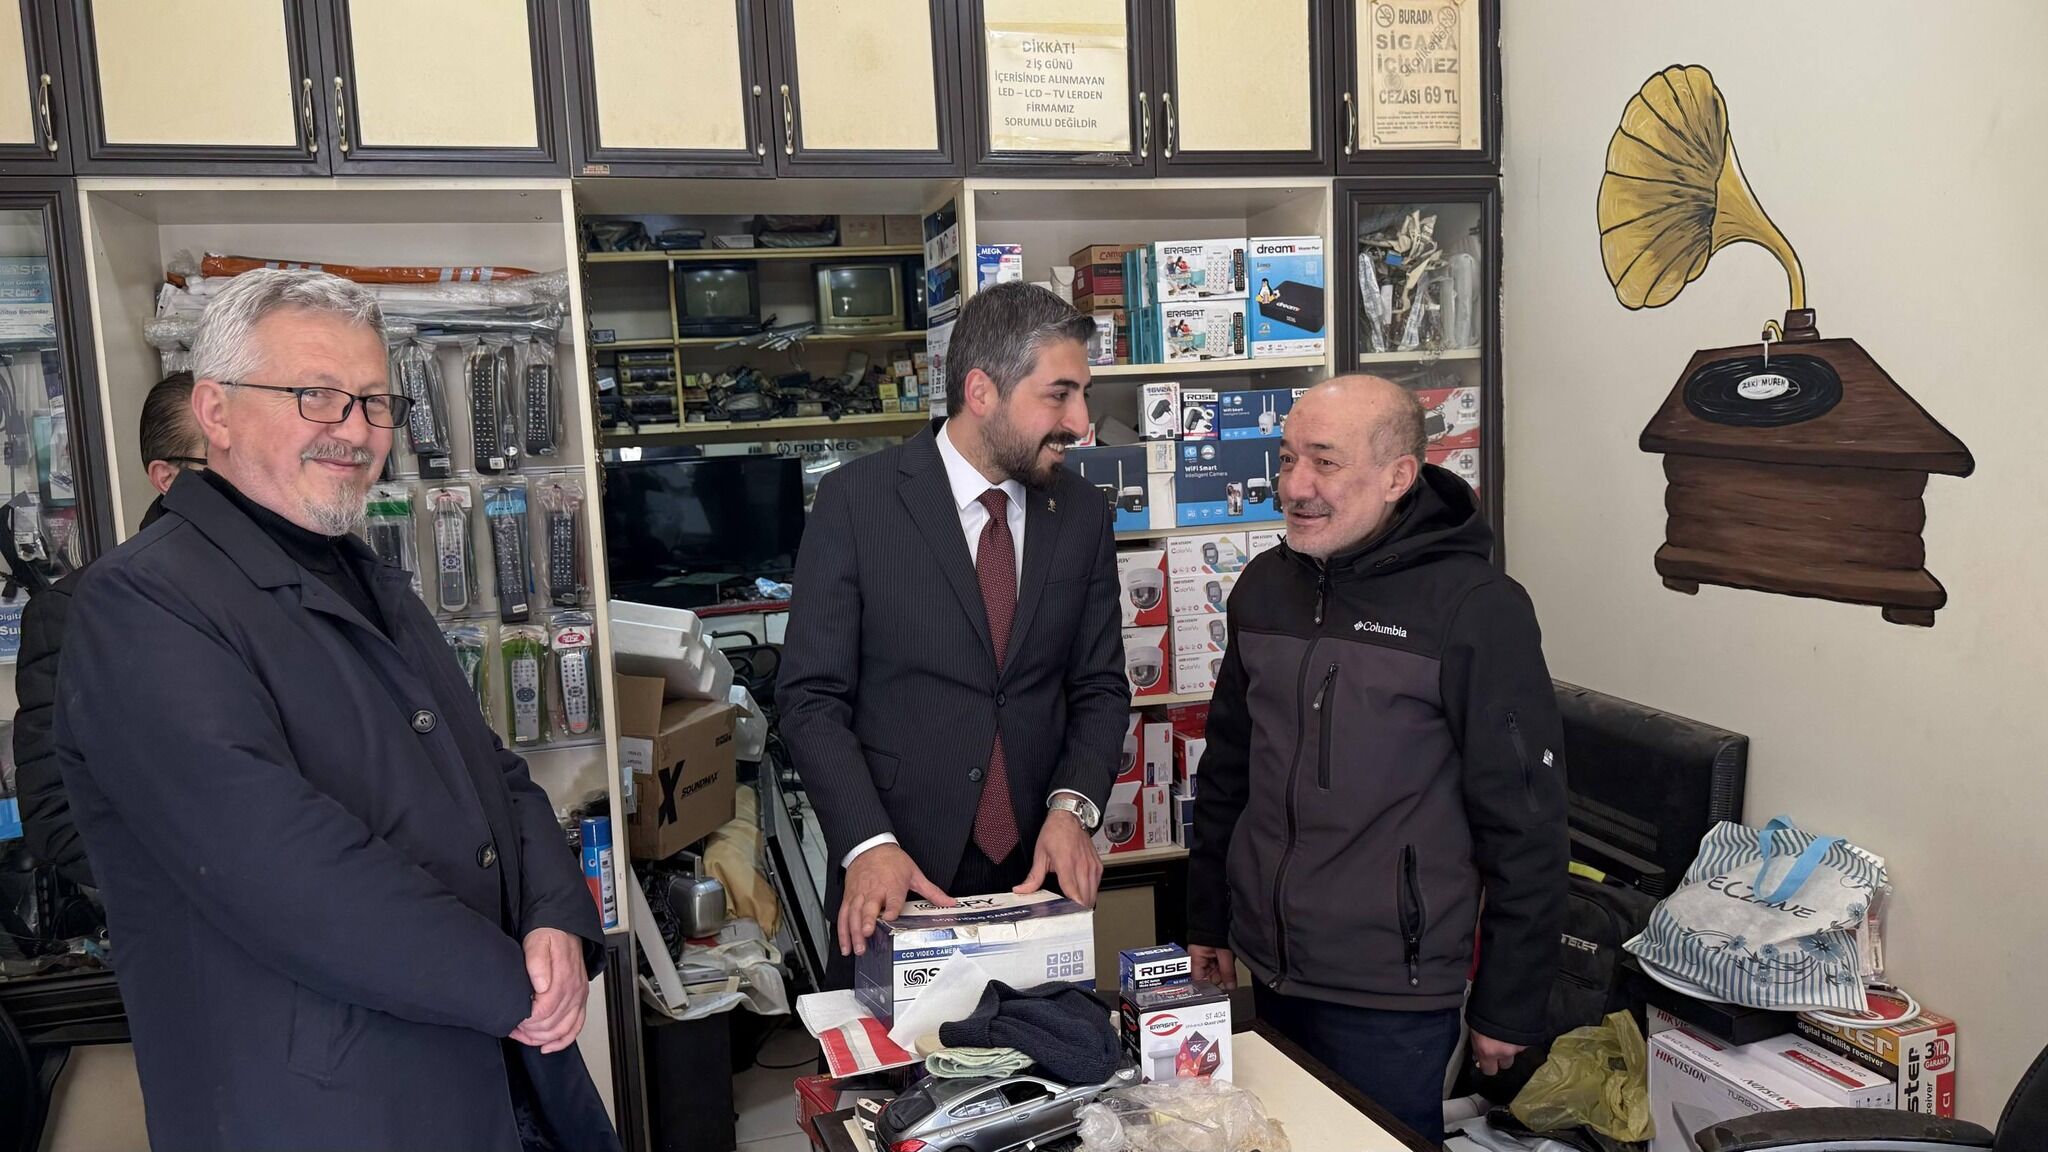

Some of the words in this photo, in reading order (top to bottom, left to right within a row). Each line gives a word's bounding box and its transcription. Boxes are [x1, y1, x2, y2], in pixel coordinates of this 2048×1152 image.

[1398, 9, 1434, 25] BURADA
[1022, 40, 1075, 55] DİKKAT!
[1025, 60, 1031, 69] 2
[1033, 59, 1042, 70] İŞ
[1045, 59, 1073, 70] GÜNÜ
[995, 71, 1046, 85] İÇERİSİNDE
[1048, 75, 1105, 86] ALINMAYAN
[998, 87, 1015, 97] LED
[1024, 89, 1042, 98] LCD
[1053, 90, 1065, 99] TV
[1067, 90, 1103, 100] LERDEN
[1424, 86, 1441, 104] 69
[1444, 89, 1458, 104] TL
[1026, 102, 1075, 114] FİRMAMIZ
[1004, 116, 1052, 128] SORUMLU
[1054, 116, 1097, 129] DEĞİLDİR
[1164, 246, 1203, 255] ERASAT
[1166, 309, 1205, 318] ERASAT
[794, 442, 858, 453] PIONEE
[1363, 621, 1407, 638] Columbia
[901, 951, 915, 959] CCD
[916, 949, 934, 957] VIDEO
[1140, 961, 1188, 977] ROSE
[1213, 1010, 1226, 1018] 404
[1656, 1009, 1688, 1028] HIKVI
[1149, 1021, 1179, 1031] ERASAT
[1797, 1021, 1821, 1037] digital
[1821, 1031, 1851, 1052] satellite
[1851, 1046, 1884, 1068] receiver
[1925, 1041, 1935, 1059] 3
[1935, 1041, 1947, 1056] YIL
[1655, 1049, 1707, 1083] HIKVISION
[1728, 1088, 1759, 1112] TURBO
